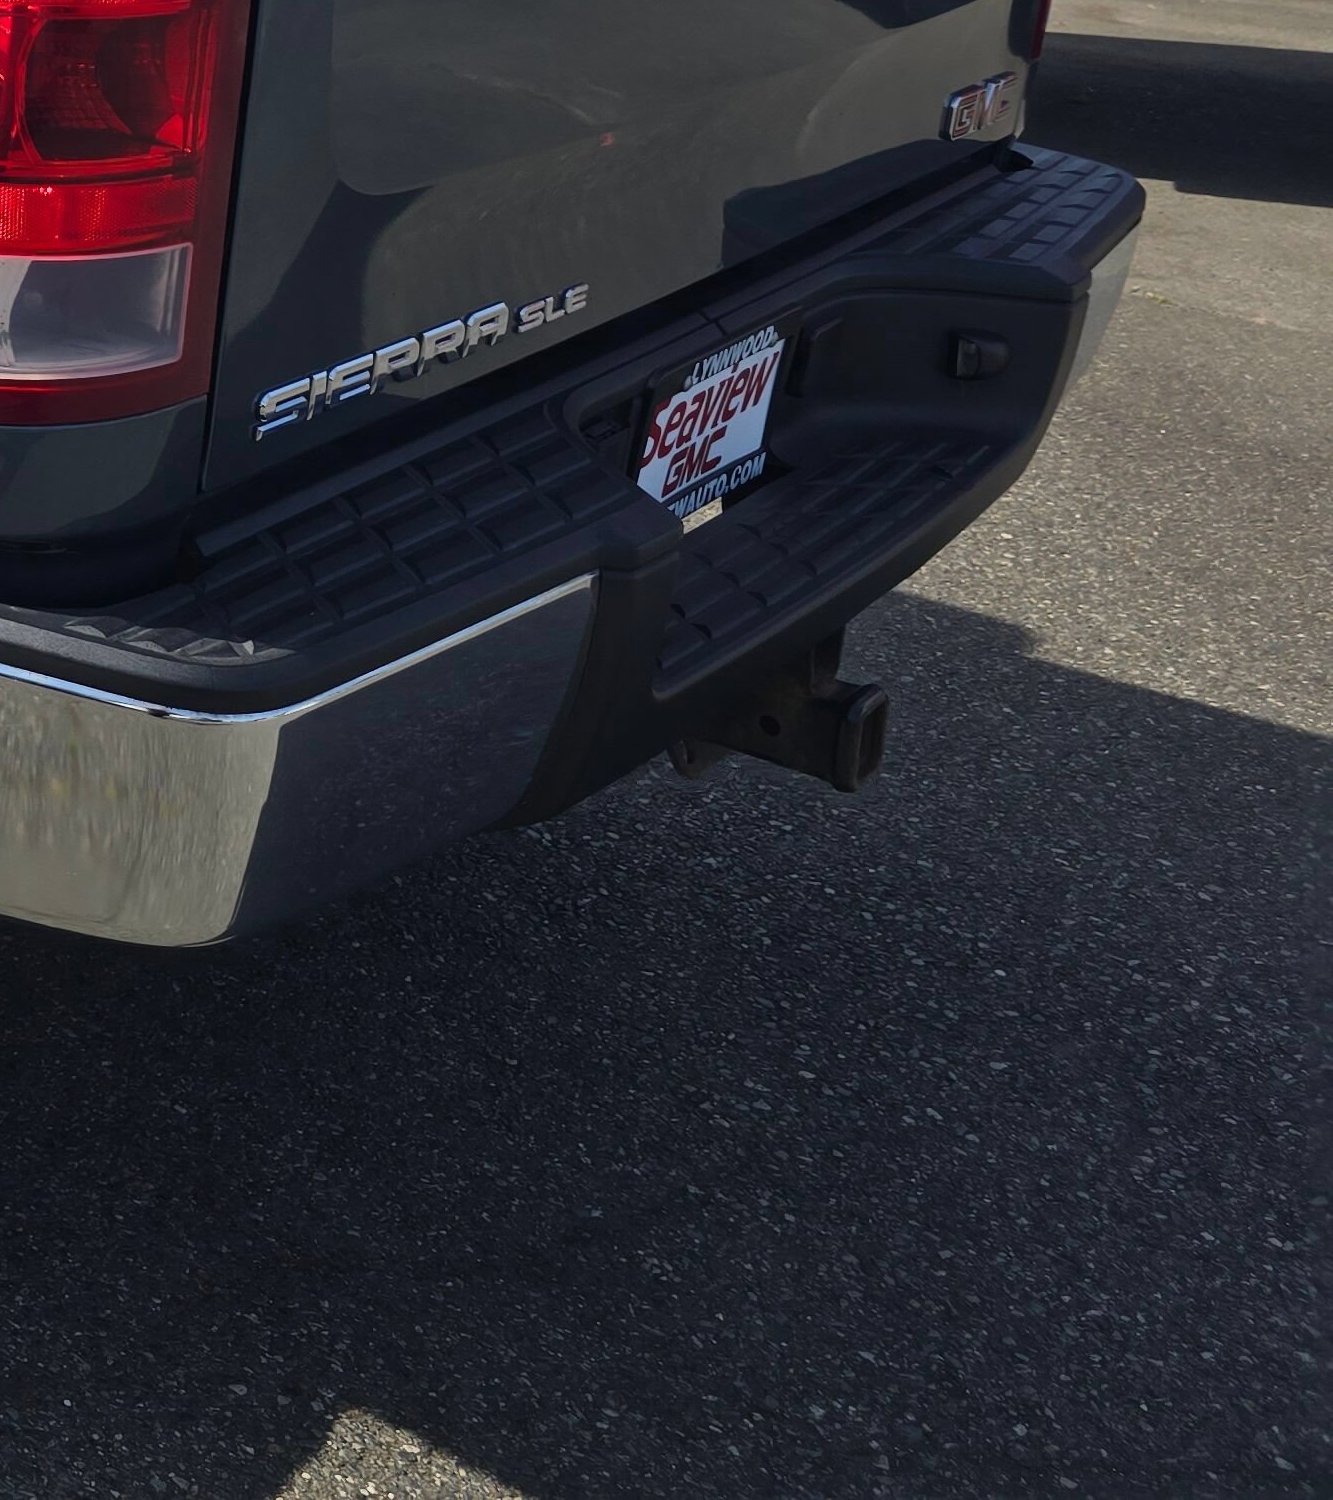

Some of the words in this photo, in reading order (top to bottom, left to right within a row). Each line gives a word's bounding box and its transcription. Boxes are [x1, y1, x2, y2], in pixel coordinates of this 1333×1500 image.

[949, 73, 1019, 140] GMC
[253, 300, 510, 443] SIERRA
[516, 281, 589, 334] SLE
[692, 325, 775, 384] LYNNWOOD
[661, 425, 728, 499] GMC
